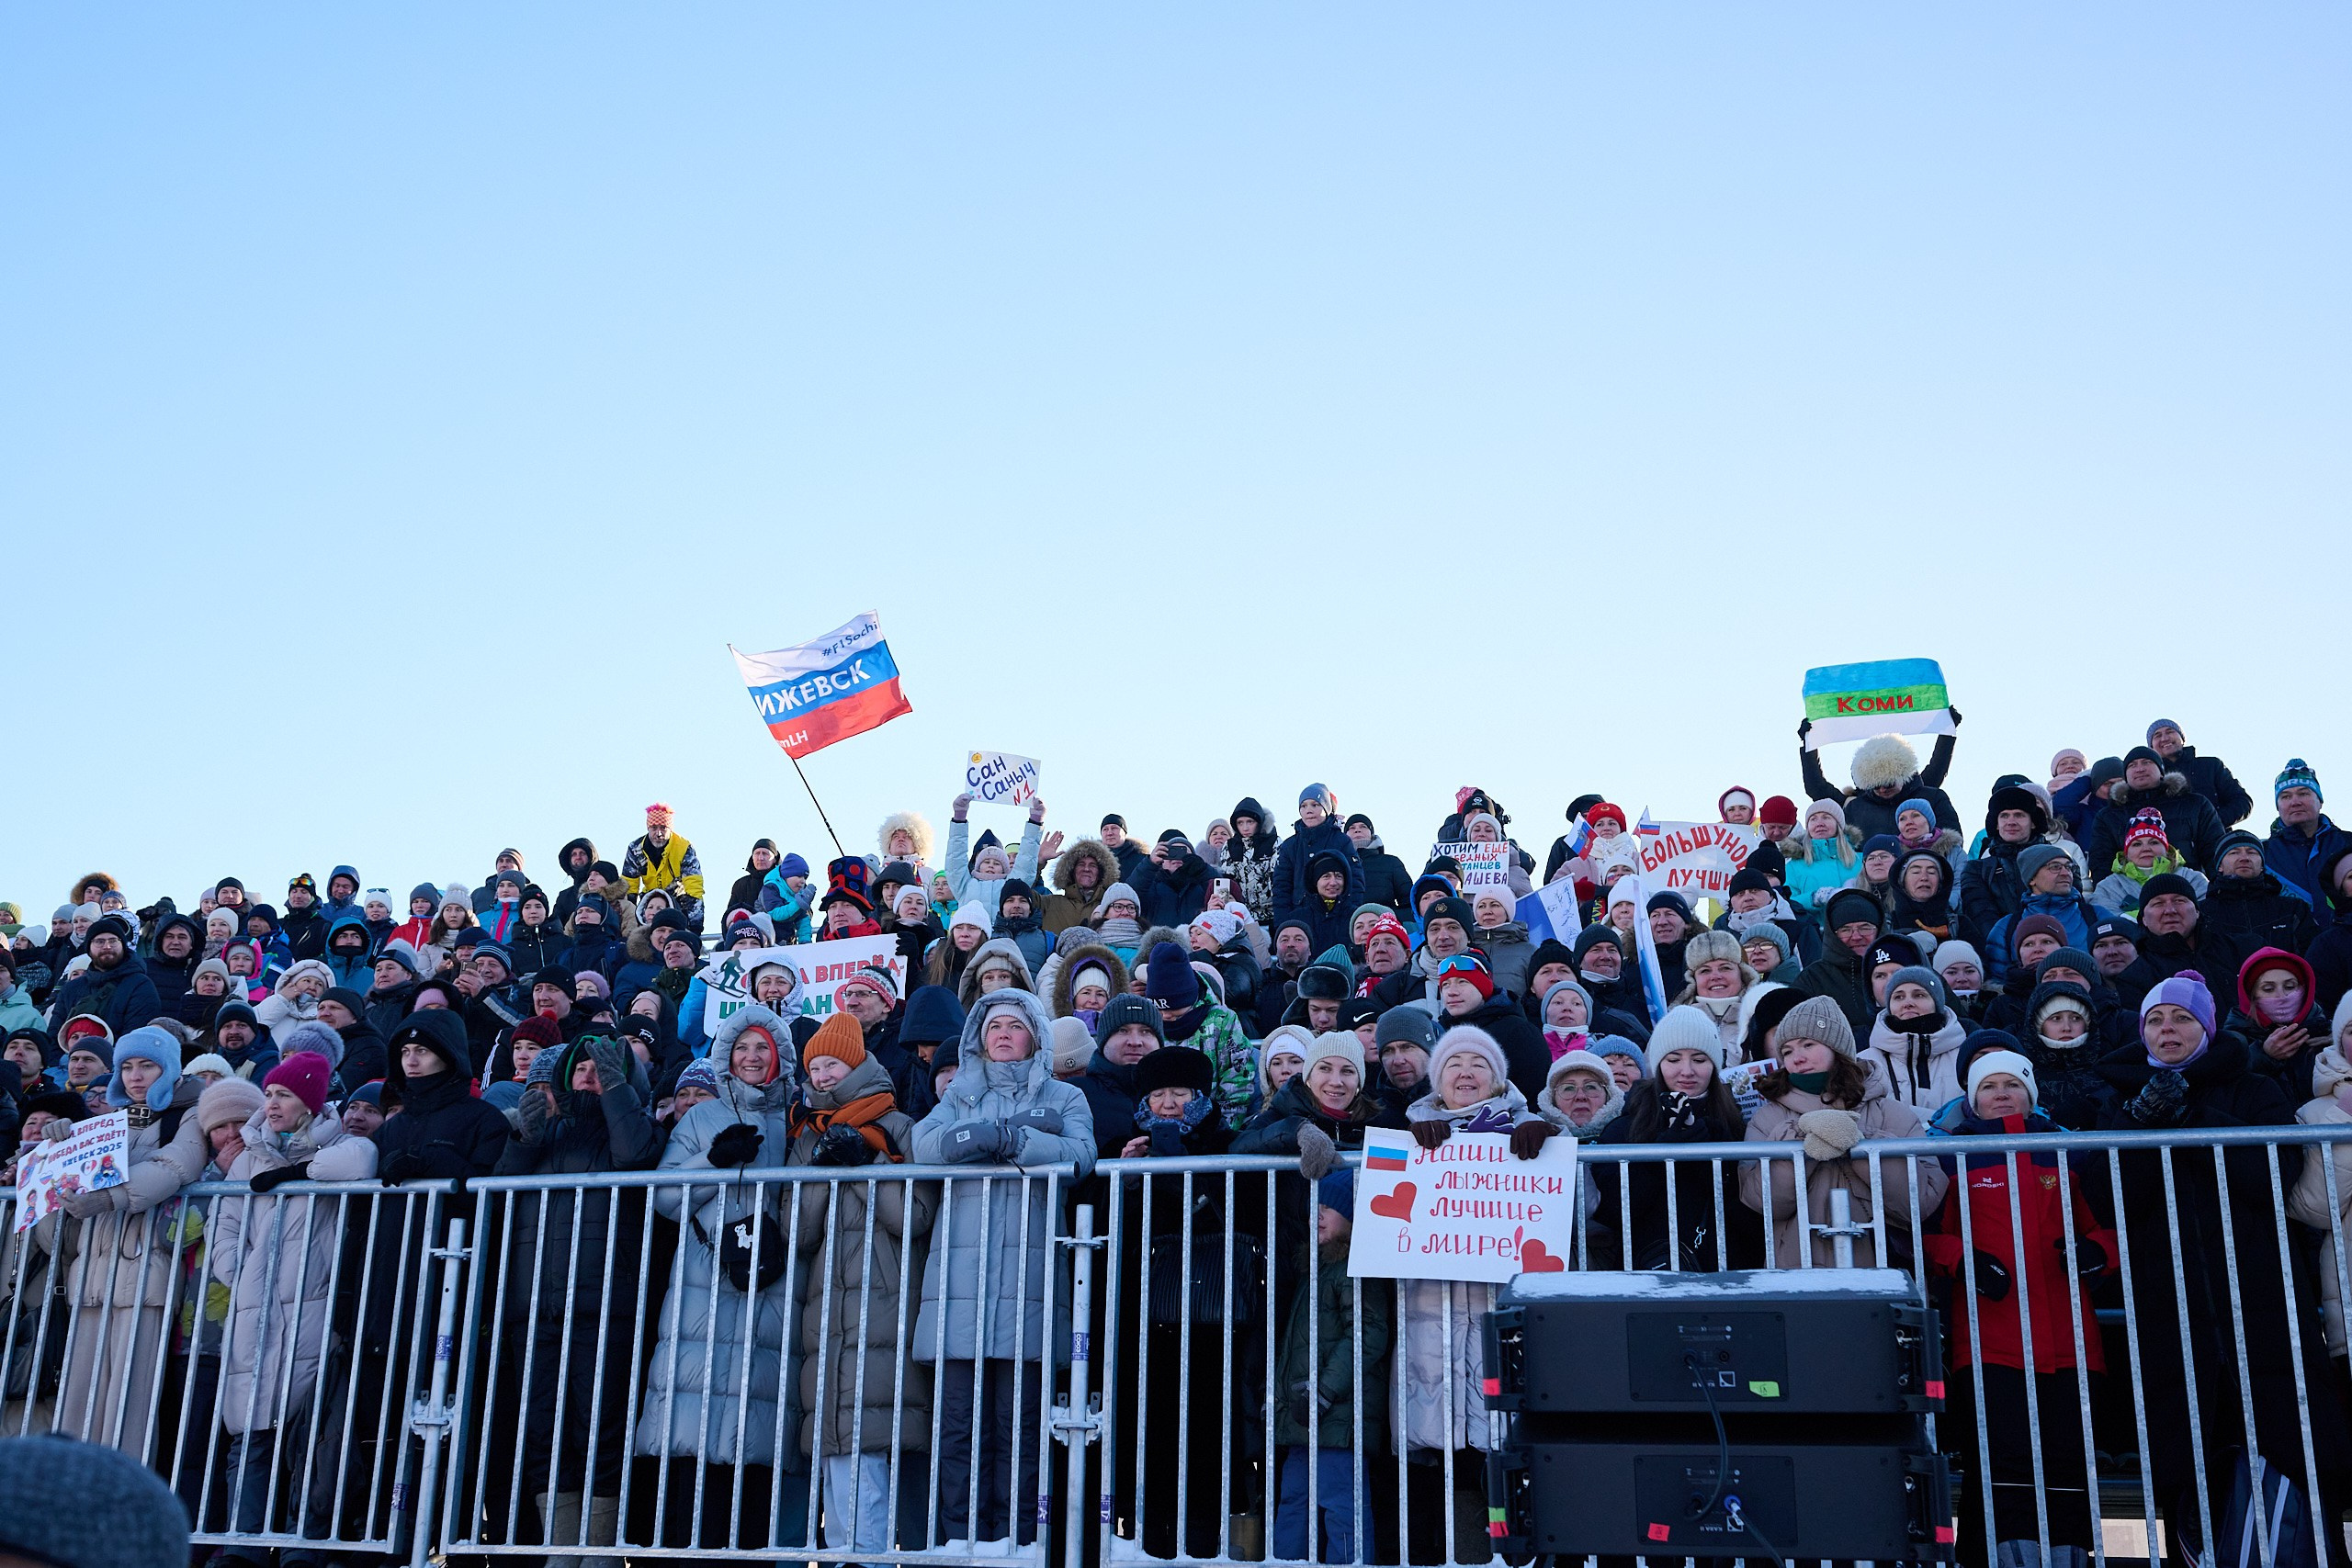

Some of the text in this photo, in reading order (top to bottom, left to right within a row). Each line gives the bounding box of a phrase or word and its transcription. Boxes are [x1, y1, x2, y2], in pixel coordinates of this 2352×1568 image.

[821, 621, 878, 657] #F1Sochi
[754, 659, 871, 716] ИЖЕВСК
[967, 755, 1007, 787] Сан
[981, 761, 1036, 801] Саныч
[1432, 842, 1479, 857] ХОТИМ
[1464, 872, 1508, 886] АШЕВА
[1667, 868, 1734, 891] ЛУЧШИ
[743, 931, 761, 940] TEAM
[1875, 948, 1891, 964] LA
[1147, 998, 1170, 1010] AR
[77, 1118, 115, 1136] ВПЕРЁД
[79, 1137, 95, 1150] ВАС
[62, 1142, 122, 1168] ИЖЕВСК 2025
[1414, 1144, 1510, 1166] Наши
[1421, 1224, 1524, 1262] мире!
